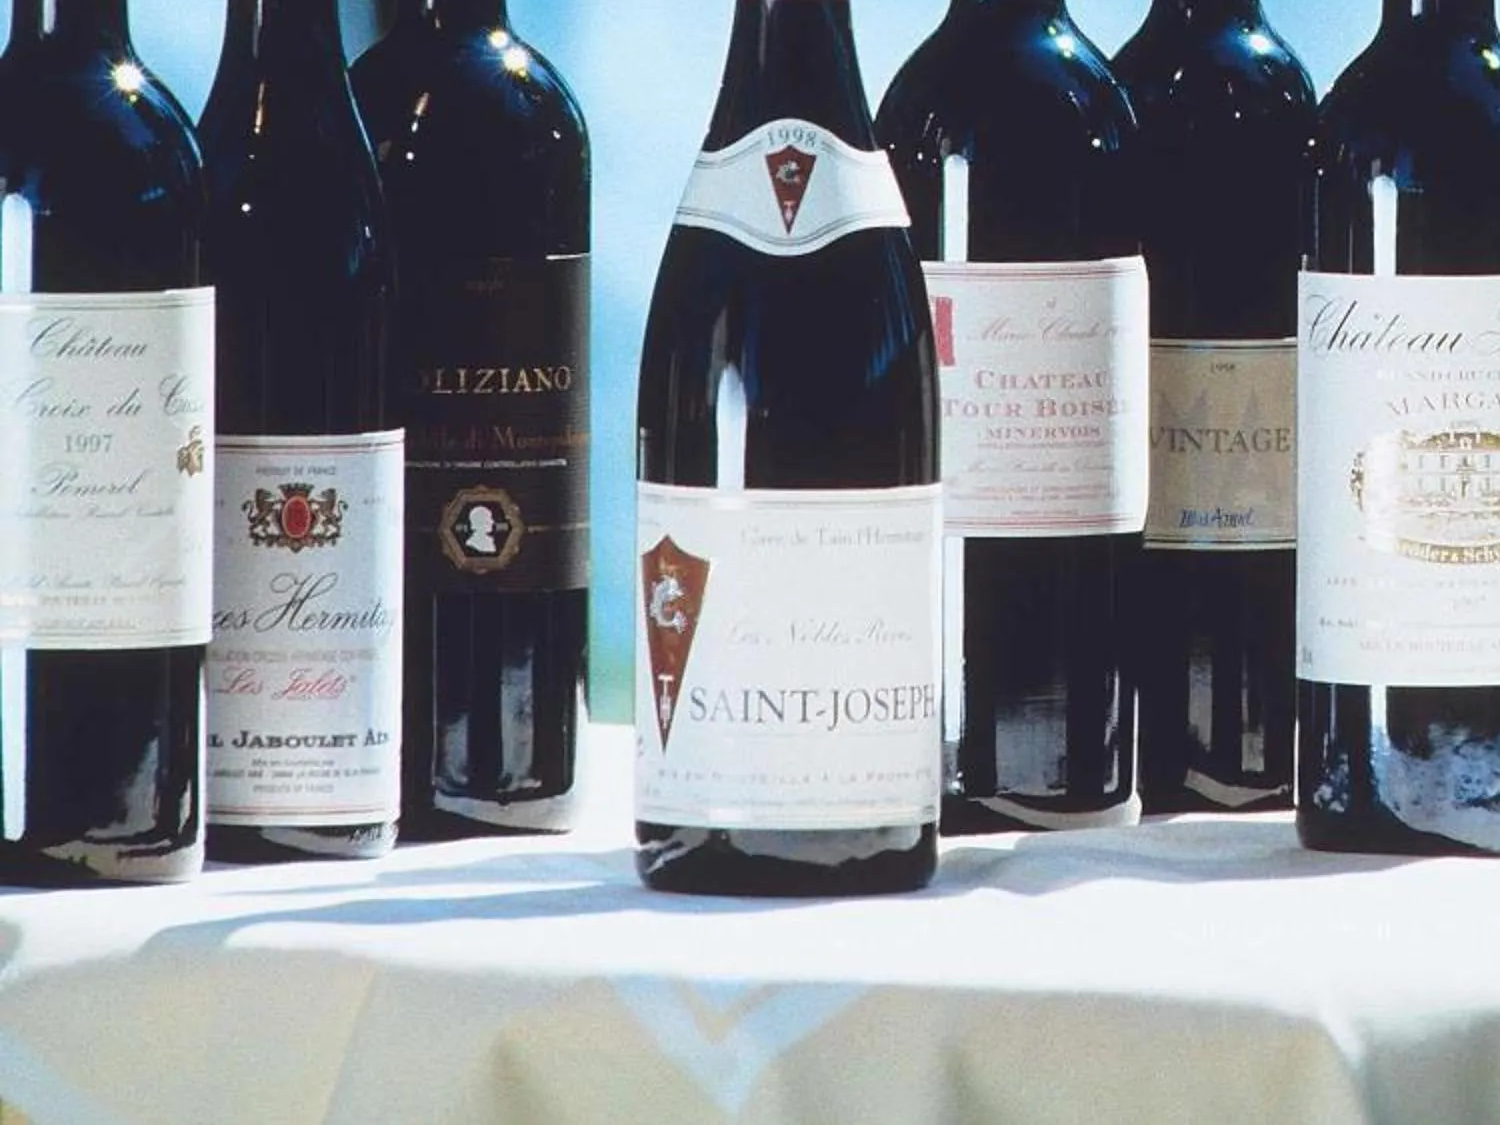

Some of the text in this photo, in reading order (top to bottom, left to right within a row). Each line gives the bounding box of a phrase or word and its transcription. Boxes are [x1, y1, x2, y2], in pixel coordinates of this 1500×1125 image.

[765, 128, 818, 148] 1998
[64, 433, 114, 454] 1997
[1150, 426, 1292, 453] VINTAGE
[689, 683, 936, 731] SAINT-JOSEPH
[231, 730, 358, 749] JABOULET
